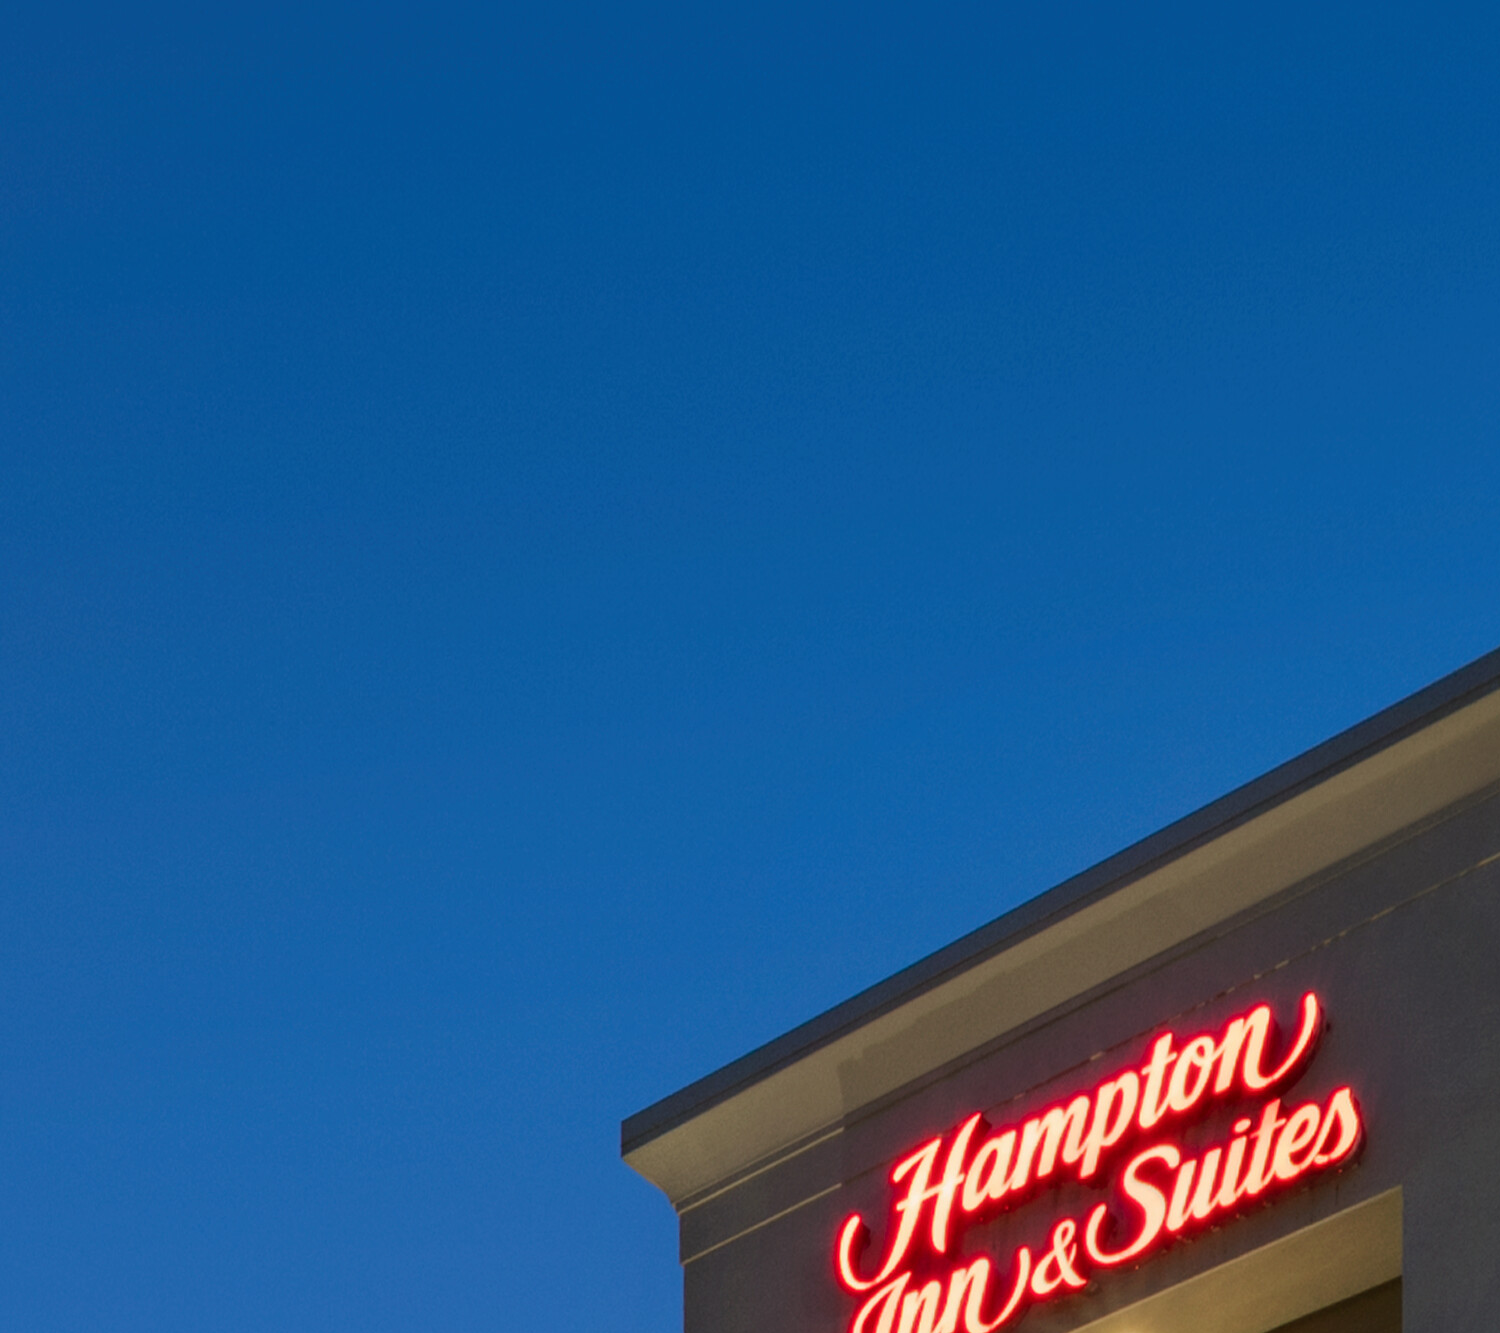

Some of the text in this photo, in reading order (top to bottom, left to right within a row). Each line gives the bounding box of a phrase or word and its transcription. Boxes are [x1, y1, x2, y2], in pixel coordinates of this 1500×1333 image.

[836, 990, 1321, 1293] Hampton
[1029, 1218, 1087, 1296] &
[1084, 1086, 1361, 1266] Suites
